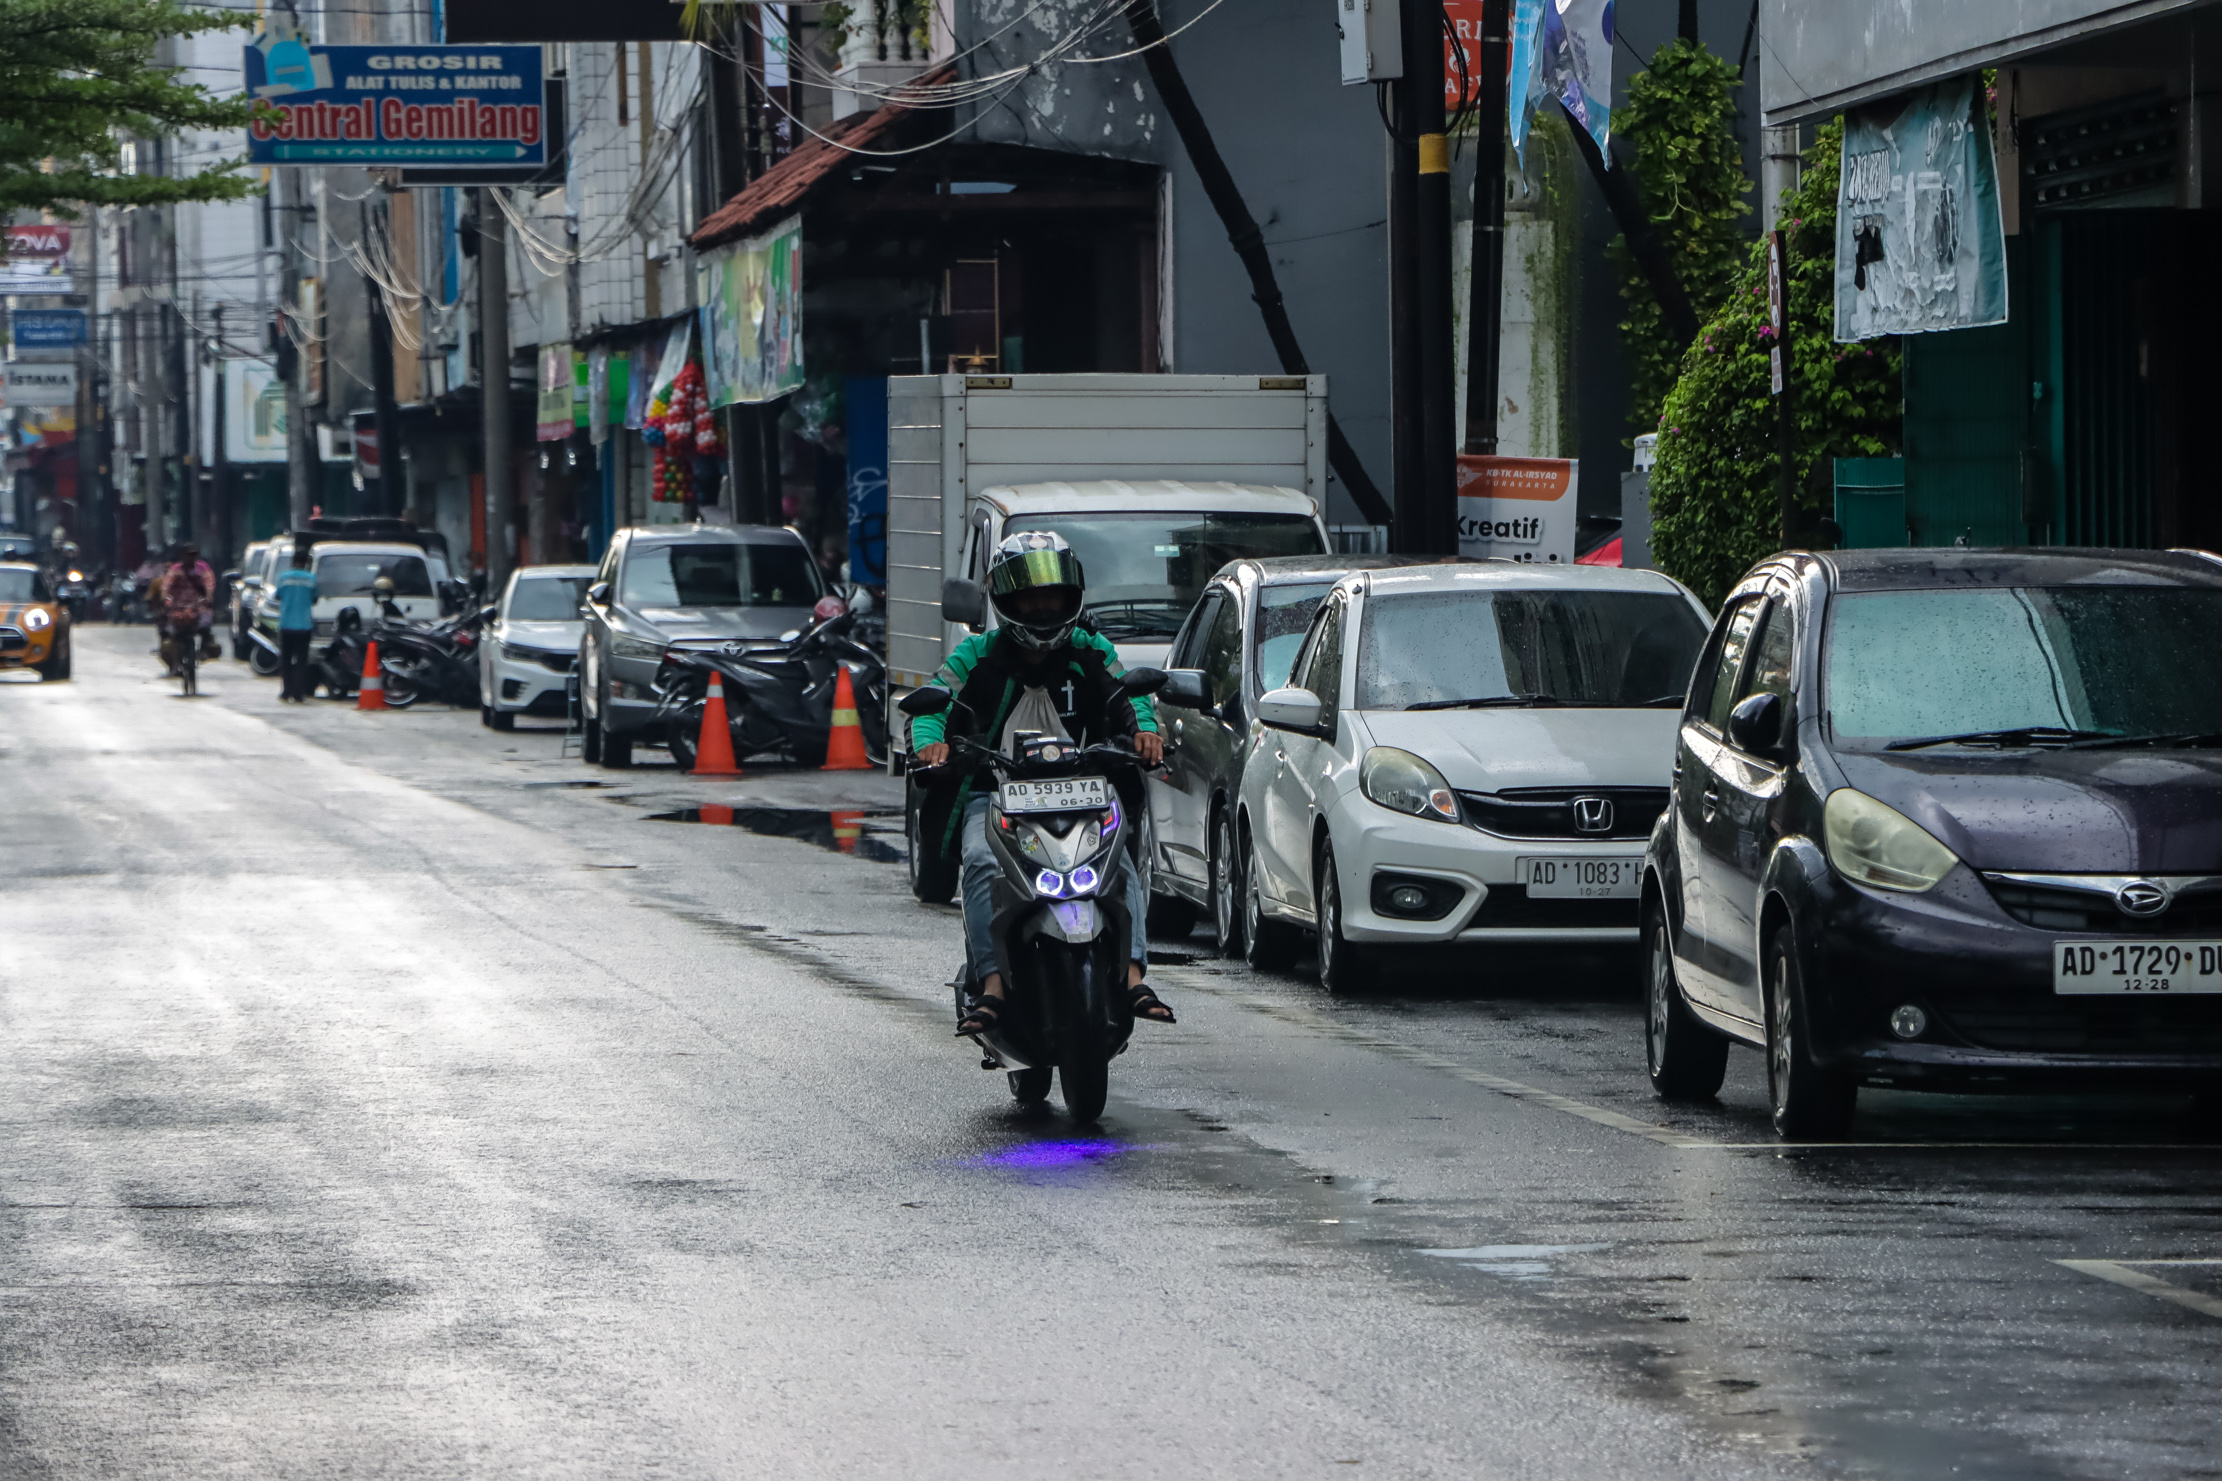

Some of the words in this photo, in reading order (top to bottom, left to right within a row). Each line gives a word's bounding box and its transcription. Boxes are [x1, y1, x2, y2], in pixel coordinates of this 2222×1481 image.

[367, 55, 502, 70] GROSIR
[345, 76, 386, 90] ALAT
[388, 76, 436, 90] TULIS
[438, 77, 452, 90] &
[454, 76, 522, 90] KANTOR
[251, 97, 375, 140] Central
[382, 97, 541, 144] Gemilang
[313, 147, 490, 156] STATIONERY
[1486, 480, 1555, 489] SURAKARTA
[1458, 516, 1538, 539] Kreatif
[1008, 784, 1028, 796] AD
[1034, 783, 1074, 795] 5939
[1079, 781, 1101, 793] YA
[1533, 862, 1556, 884] AD
[1574, 862, 1620, 884] 1083
[2062, 946, 2095, 976] AD
[2111, 945, 2181, 975] 1729
